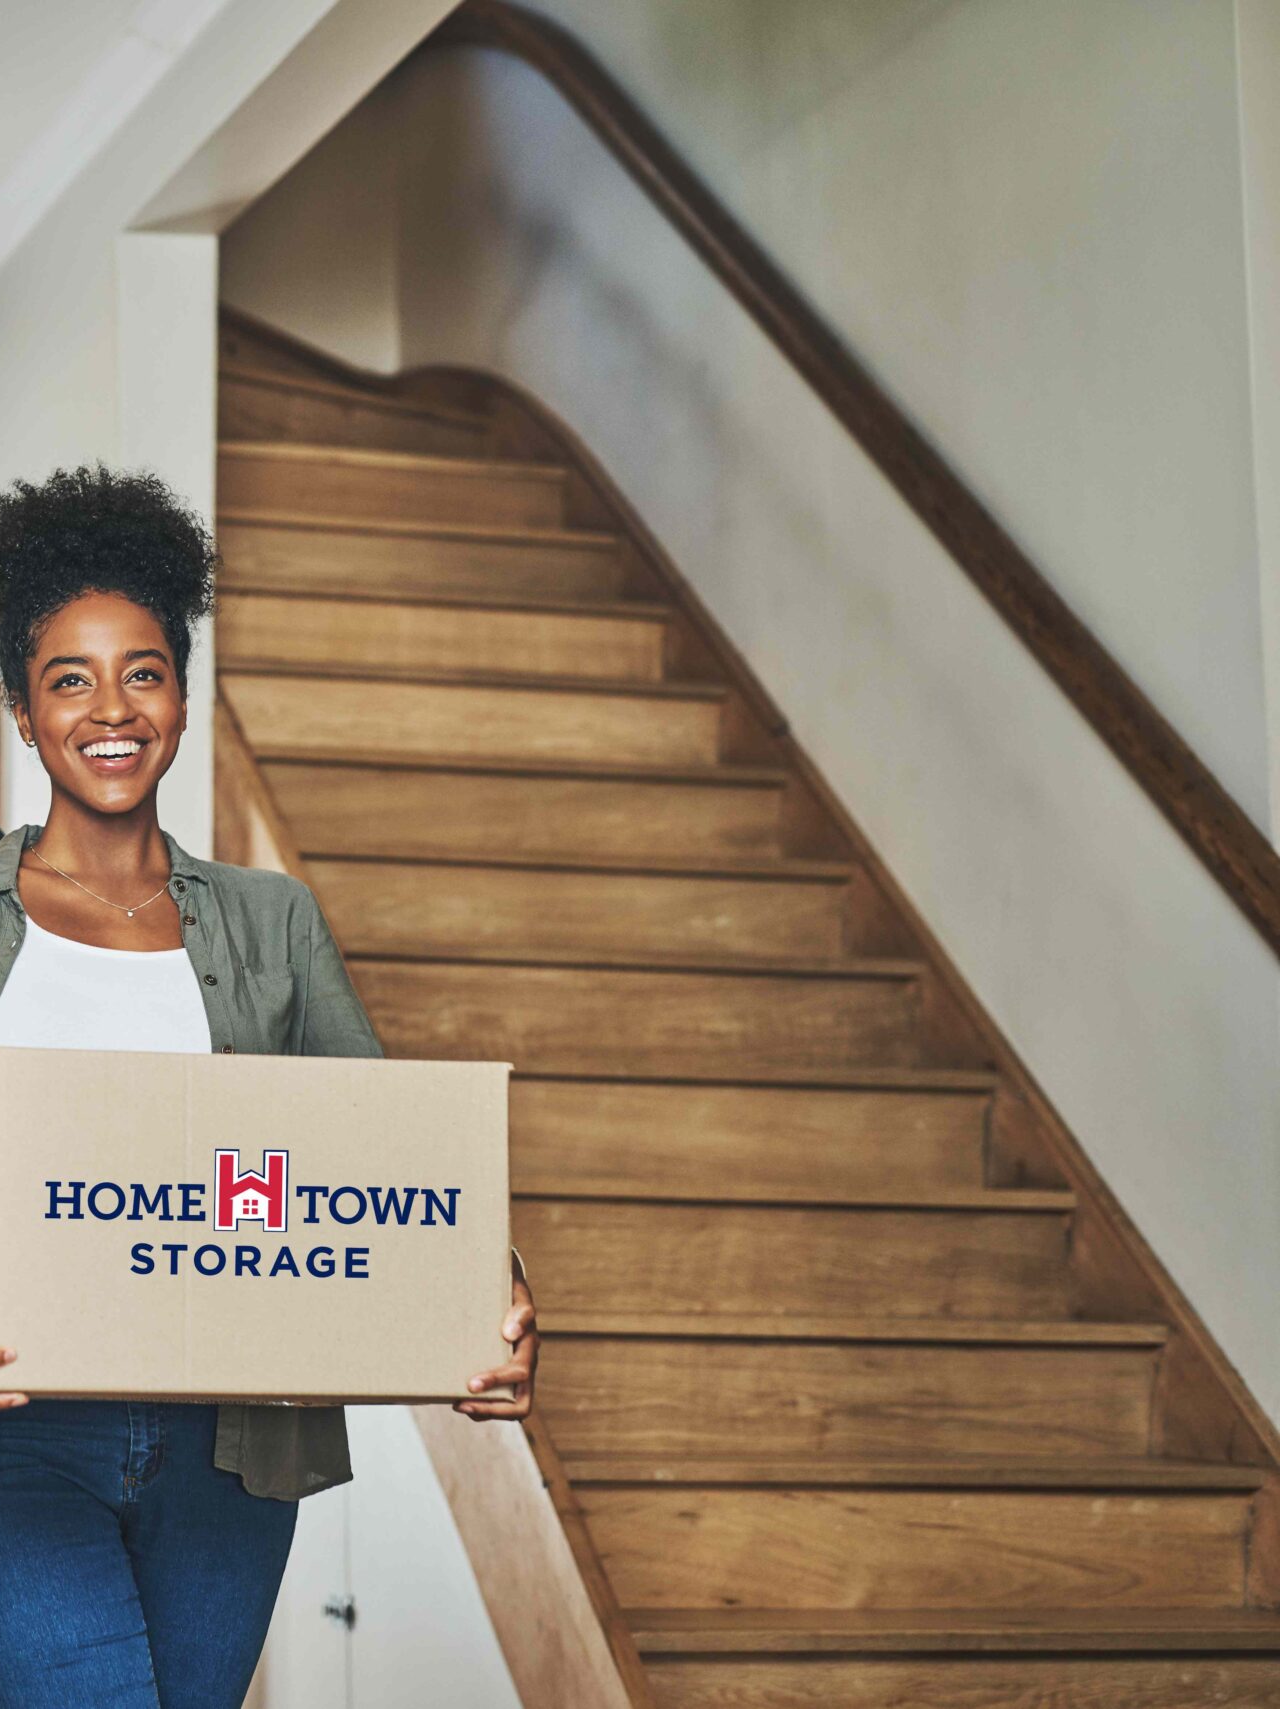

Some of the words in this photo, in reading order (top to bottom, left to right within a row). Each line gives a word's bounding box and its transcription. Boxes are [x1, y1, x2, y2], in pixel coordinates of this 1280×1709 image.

[44, 1180, 206, 1222] HOME
[296, 1186, 462, 1226] TOWN
[130, 1243, 369, 1280] STORAGE
